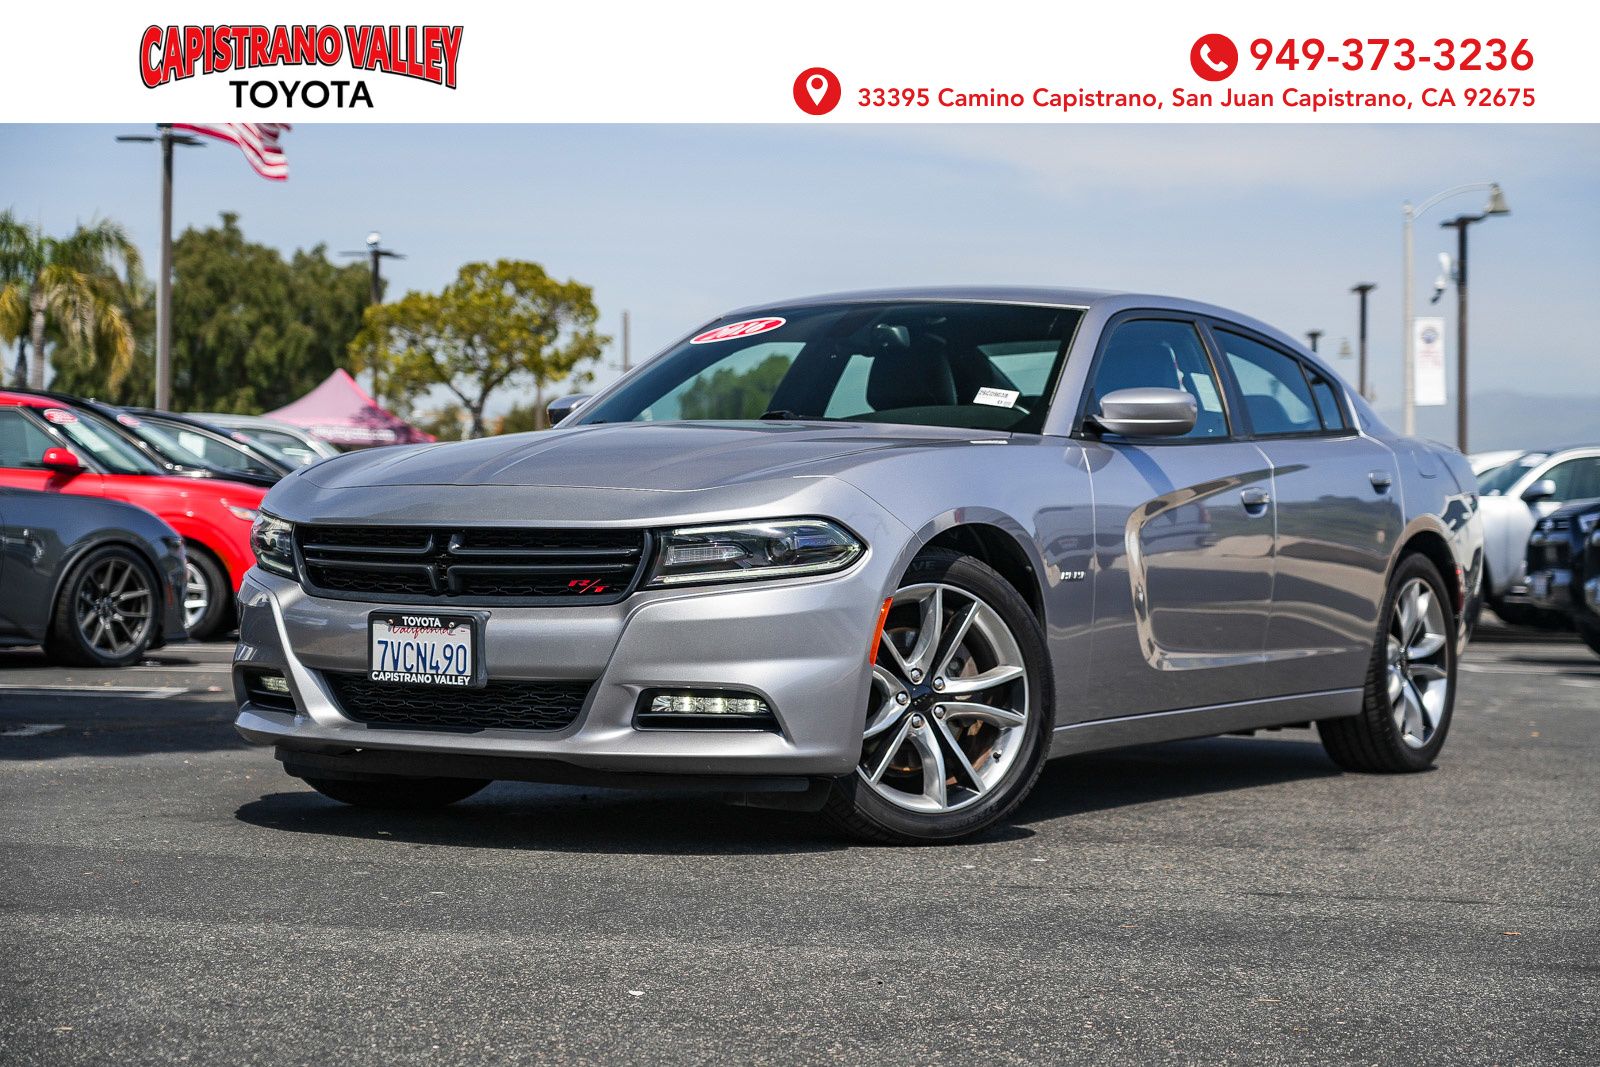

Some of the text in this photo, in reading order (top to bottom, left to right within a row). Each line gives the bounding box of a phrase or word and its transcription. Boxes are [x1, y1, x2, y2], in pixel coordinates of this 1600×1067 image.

[402, 616, 441, 627] TOYOTA
[377, 640, 467, 675] 7VCN490
[372, 671, 470, 686] CAPISTRANO VALLEY
